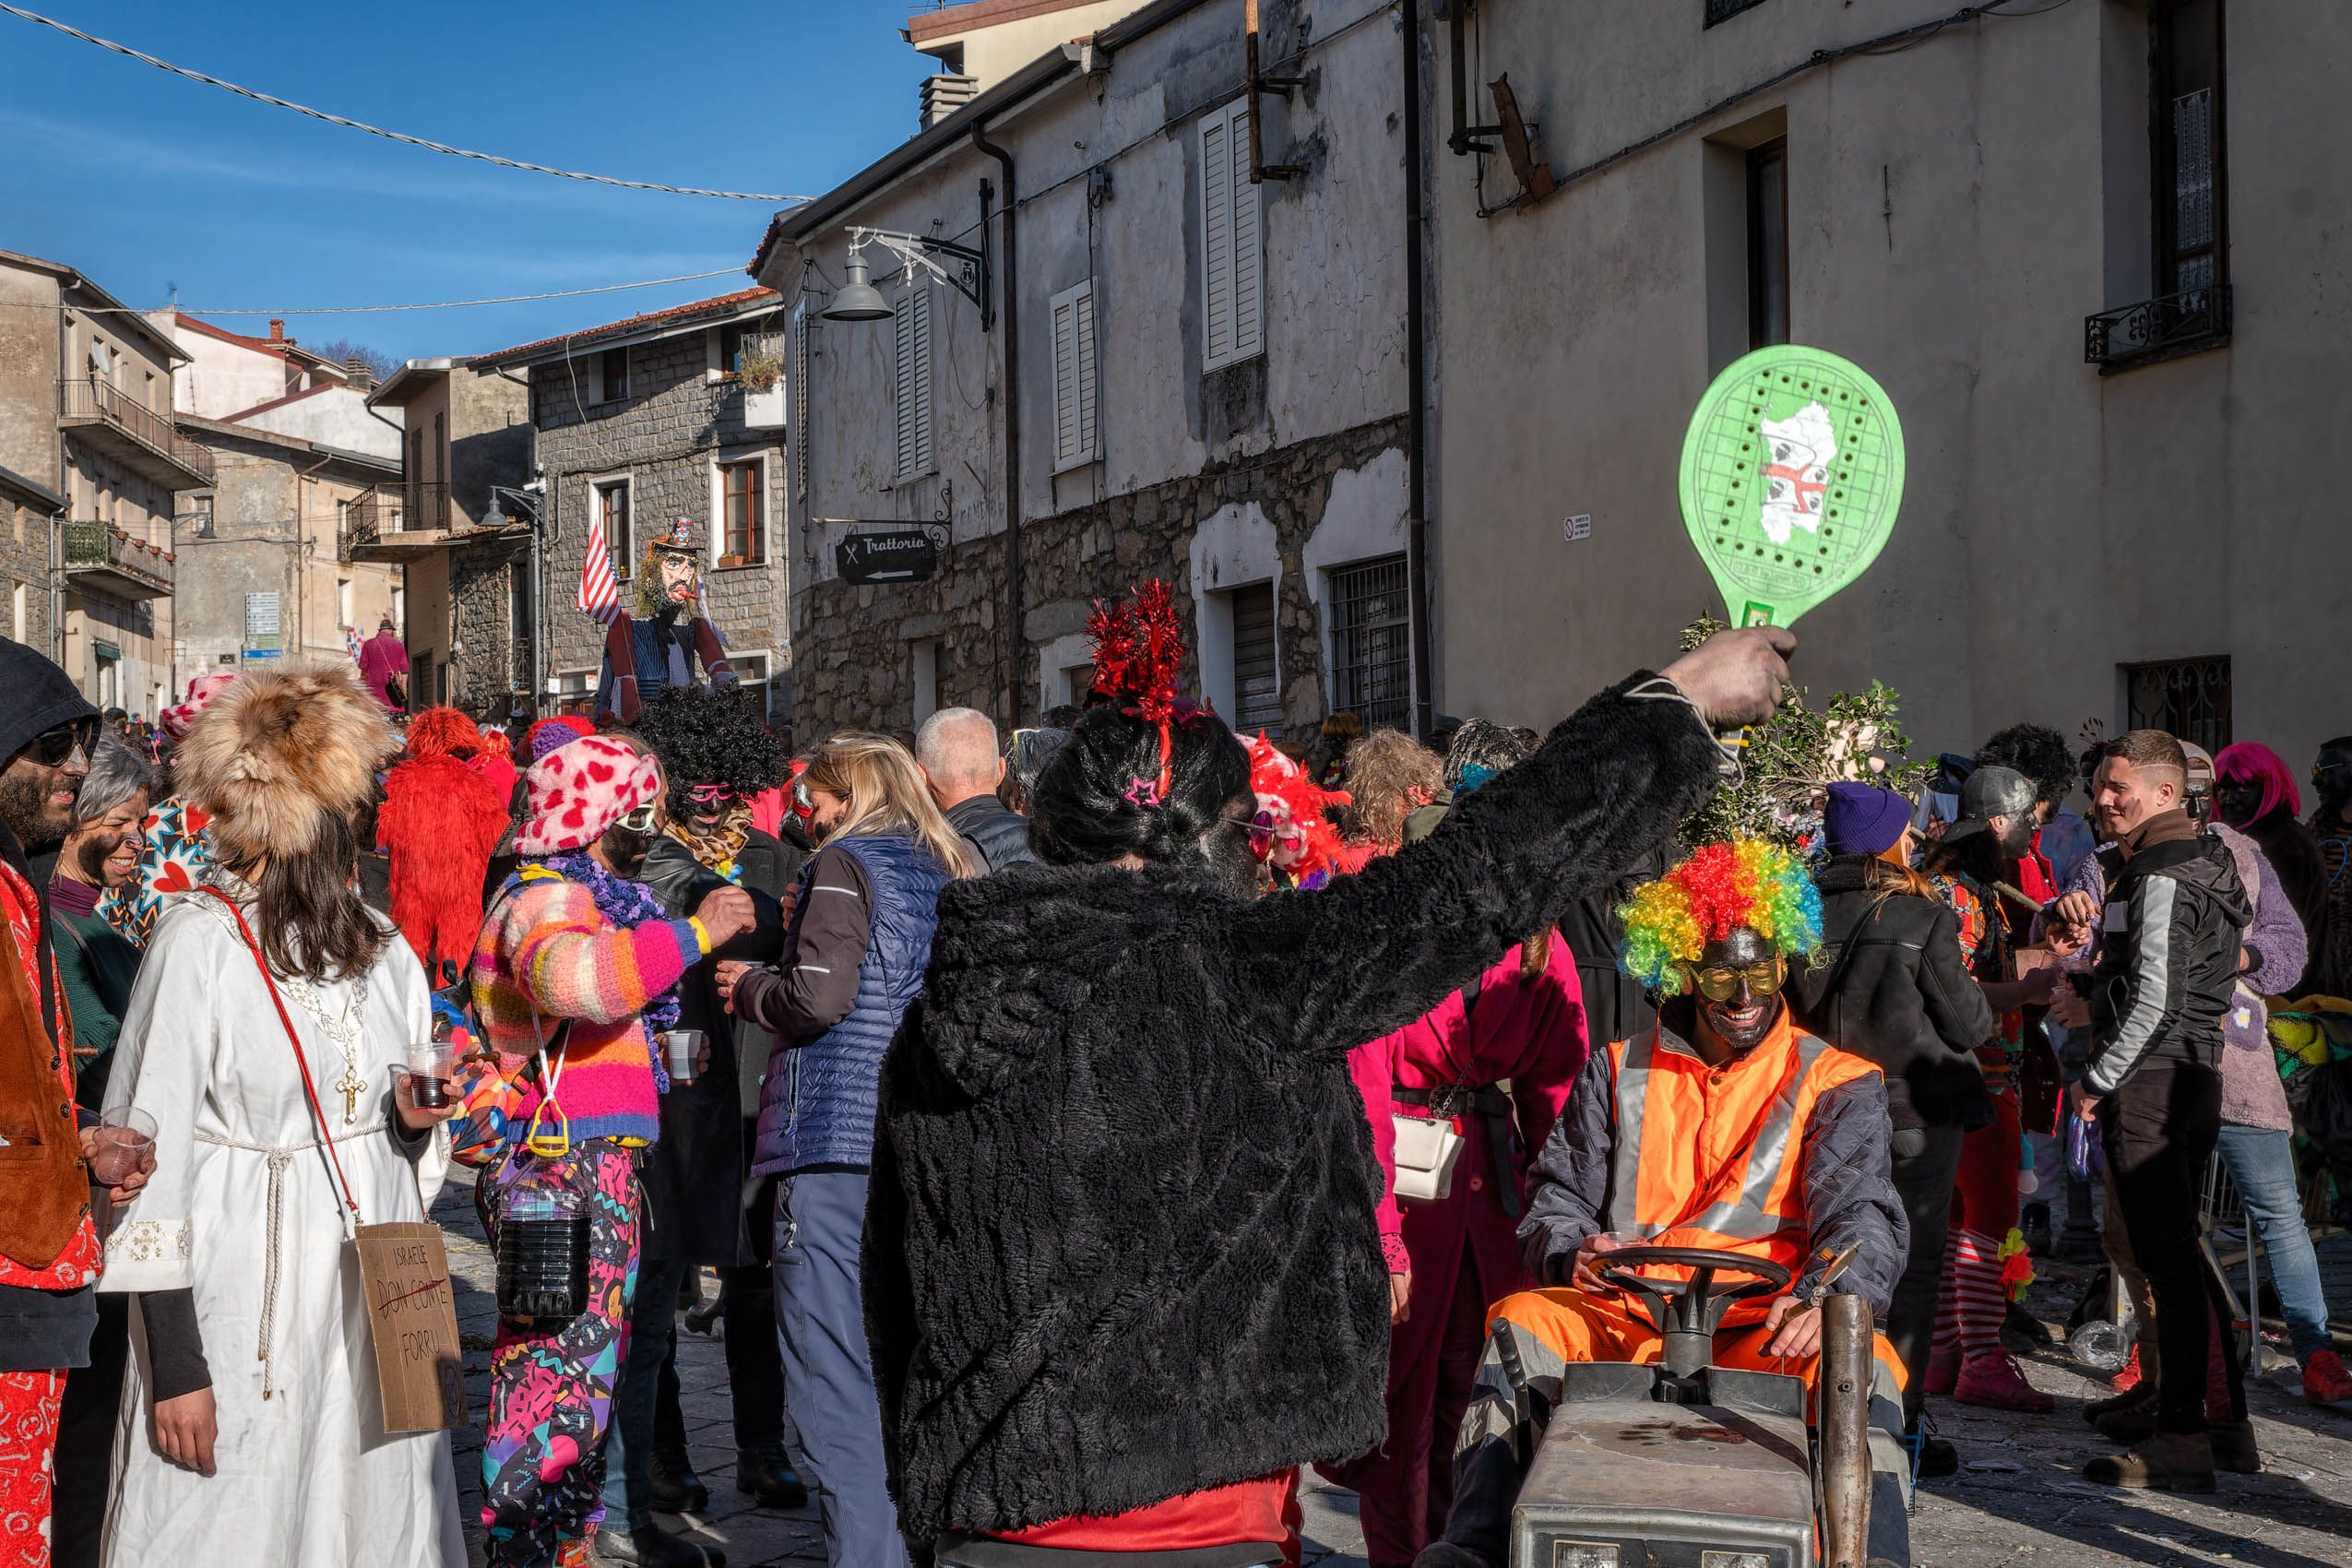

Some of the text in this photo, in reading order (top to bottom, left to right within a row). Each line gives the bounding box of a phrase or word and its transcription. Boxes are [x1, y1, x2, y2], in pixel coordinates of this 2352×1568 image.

[863, 537, 925, 554] Trattoria
[393, 1245, 428, 1269] ISRAELE
[377, 1278, 448, 1320] DON CONTE
[402, 1329, 441, 1367] FORRU
